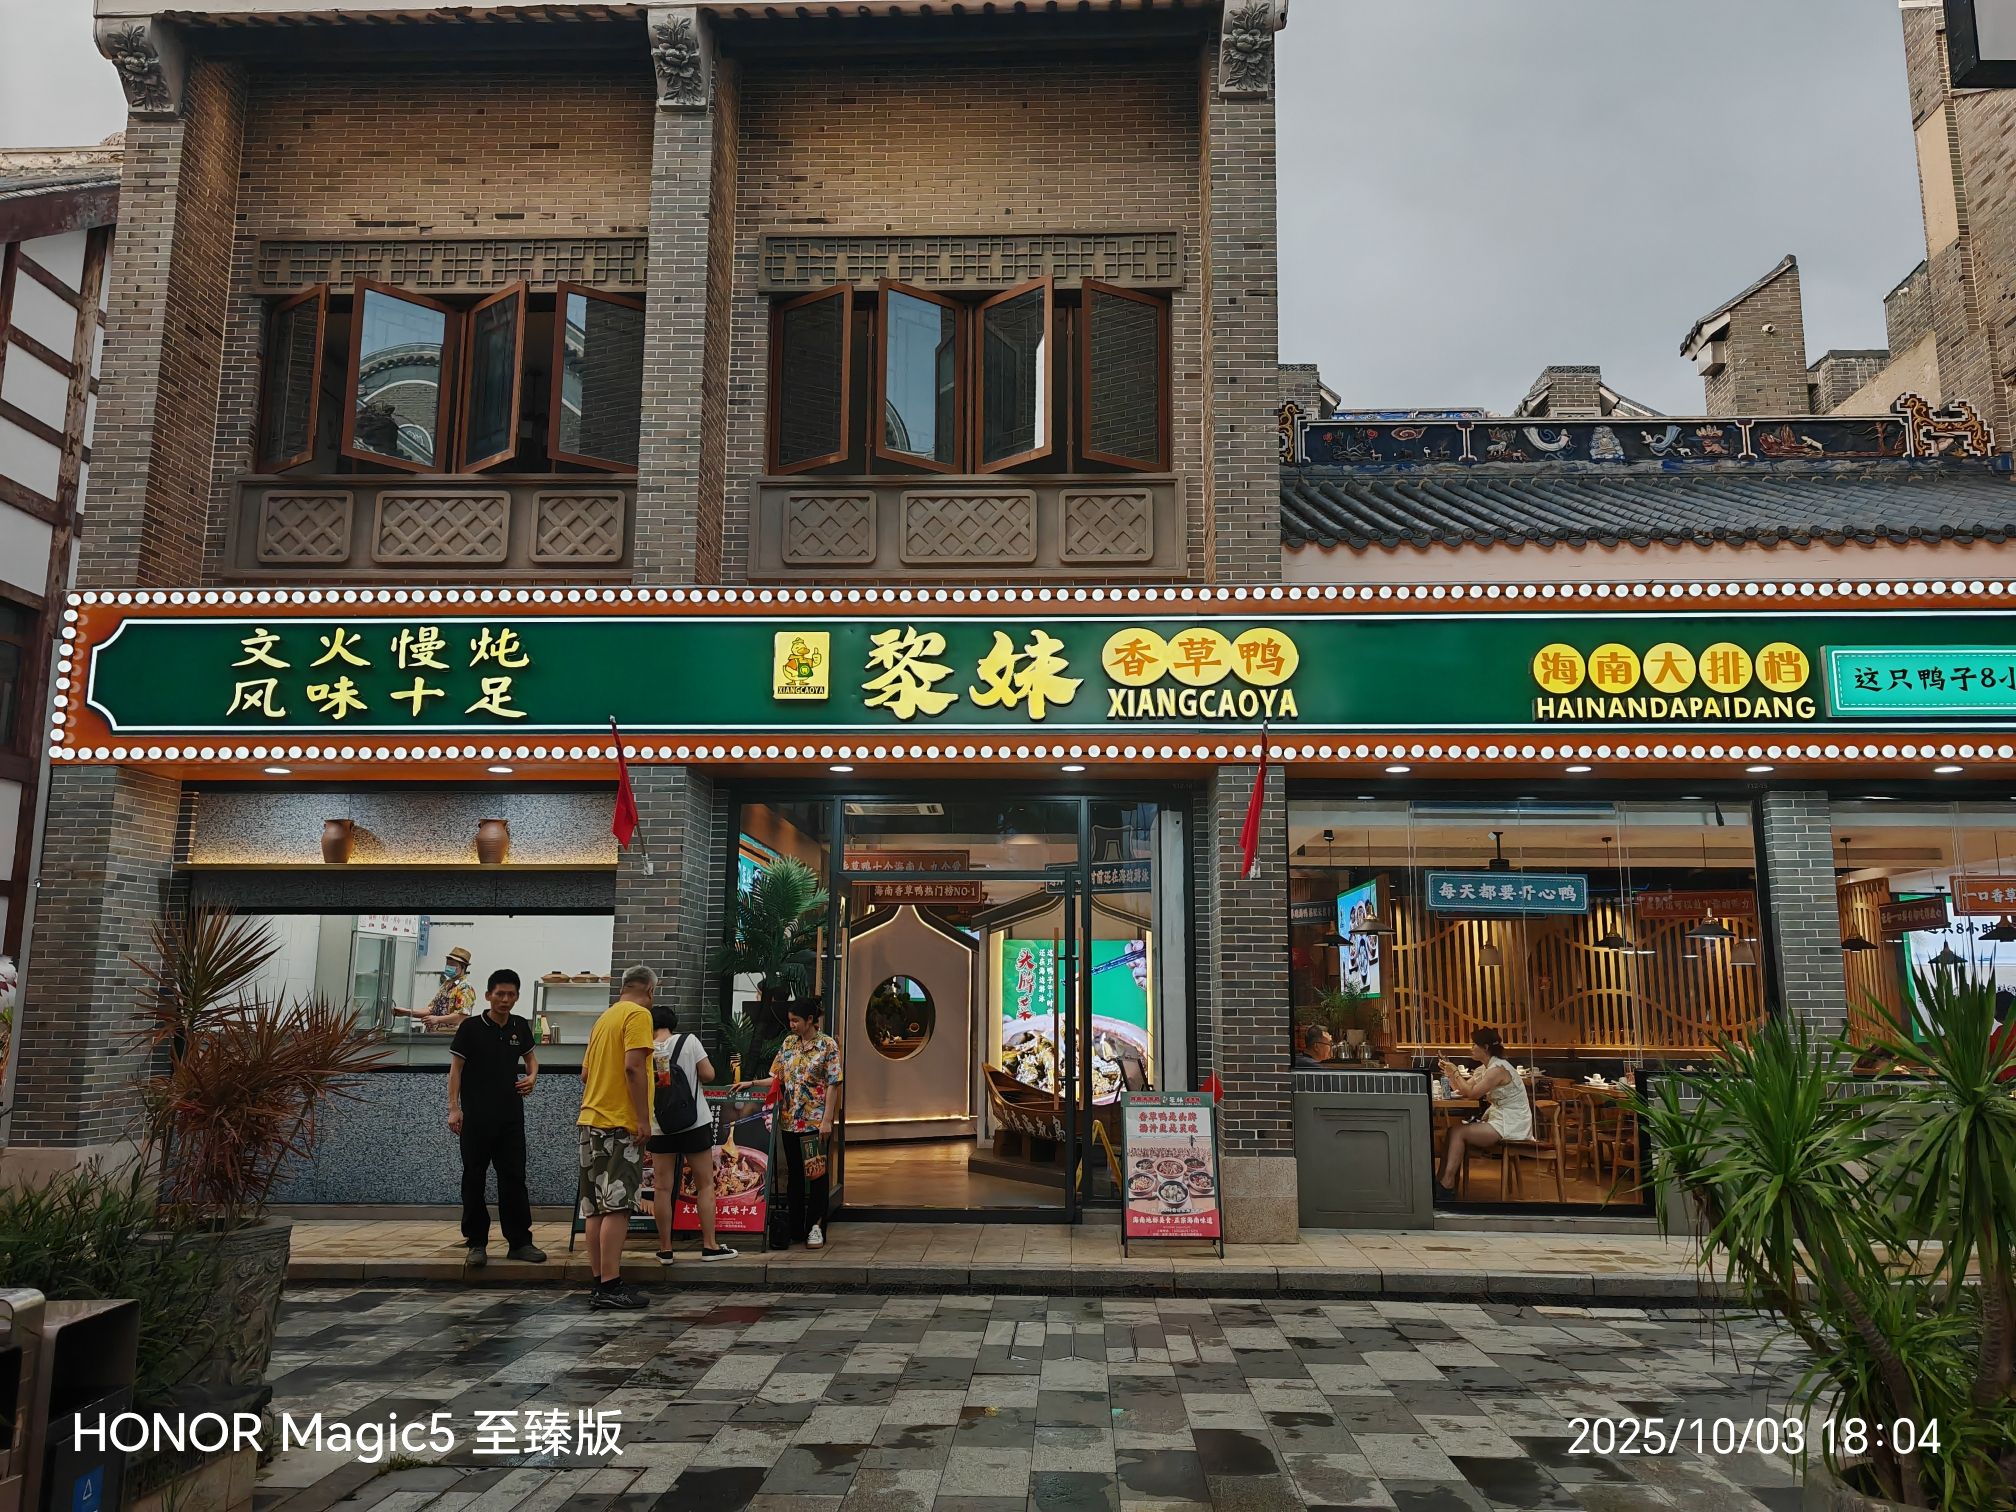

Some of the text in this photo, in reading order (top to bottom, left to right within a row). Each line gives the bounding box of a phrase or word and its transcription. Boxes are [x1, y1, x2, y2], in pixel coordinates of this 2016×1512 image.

[231, 627, 529, 669] 文火慢炖
[1110, 637, 1283, 677] 香草鸭
[862, 625, 1084, 721] 黎妹
[1540, 650, 1803, 686] 海南大排档
[226, 675, 528, 720] 风味十足
[778, 686, 824, 695] XIANGCAOYA
[1106, 688, 1299, 719] XIANGCAOYA
[1536, 696, 1816, 720] HAINANDAPAIDANG
[1438, 882, 1577, 902] 每天都要开心鸭
